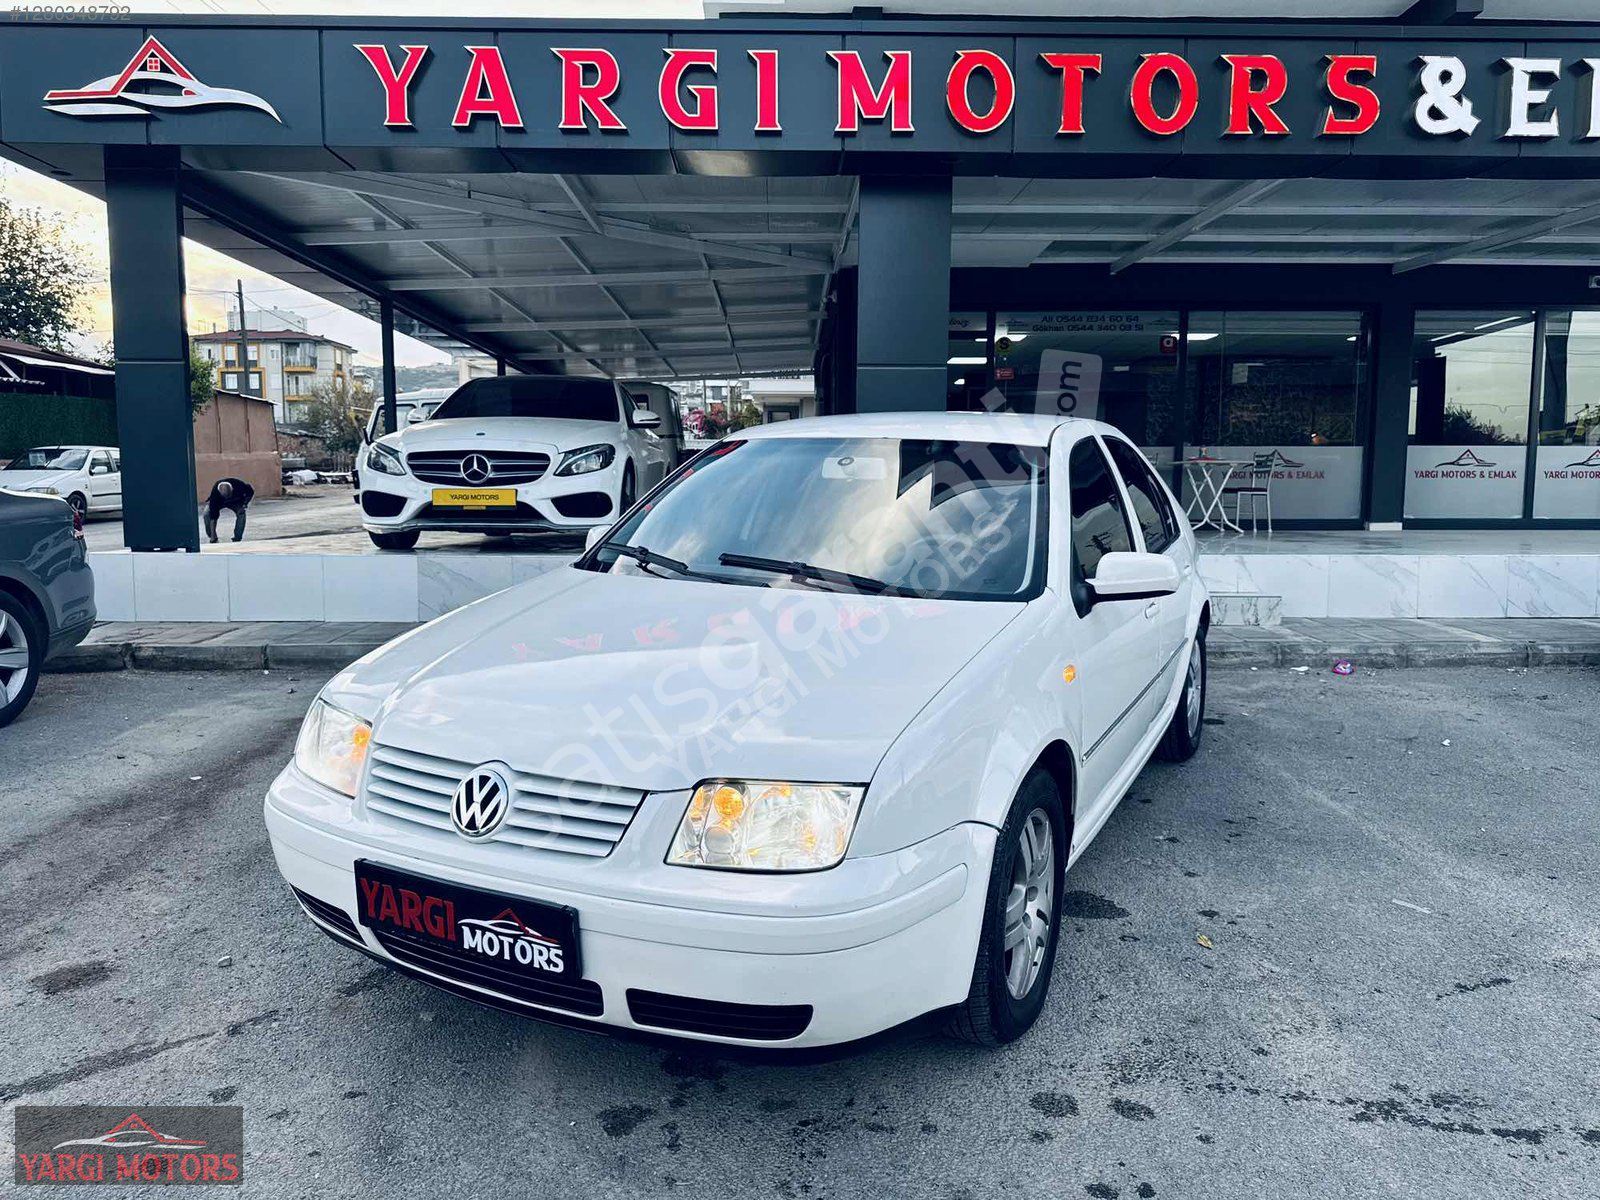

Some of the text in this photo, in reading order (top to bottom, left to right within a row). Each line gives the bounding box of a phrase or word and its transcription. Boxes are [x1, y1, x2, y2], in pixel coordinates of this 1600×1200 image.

[353, 43, 782, 132] YARGI
[825, 50, 1380, 135] MOTORS
[1414, 470, 1517, 479] YARGI MOTORS & EMLAK
[1544, 470, 1568, 480] YARGI
[360, 877, 564, 973] YARGI MOTORS
